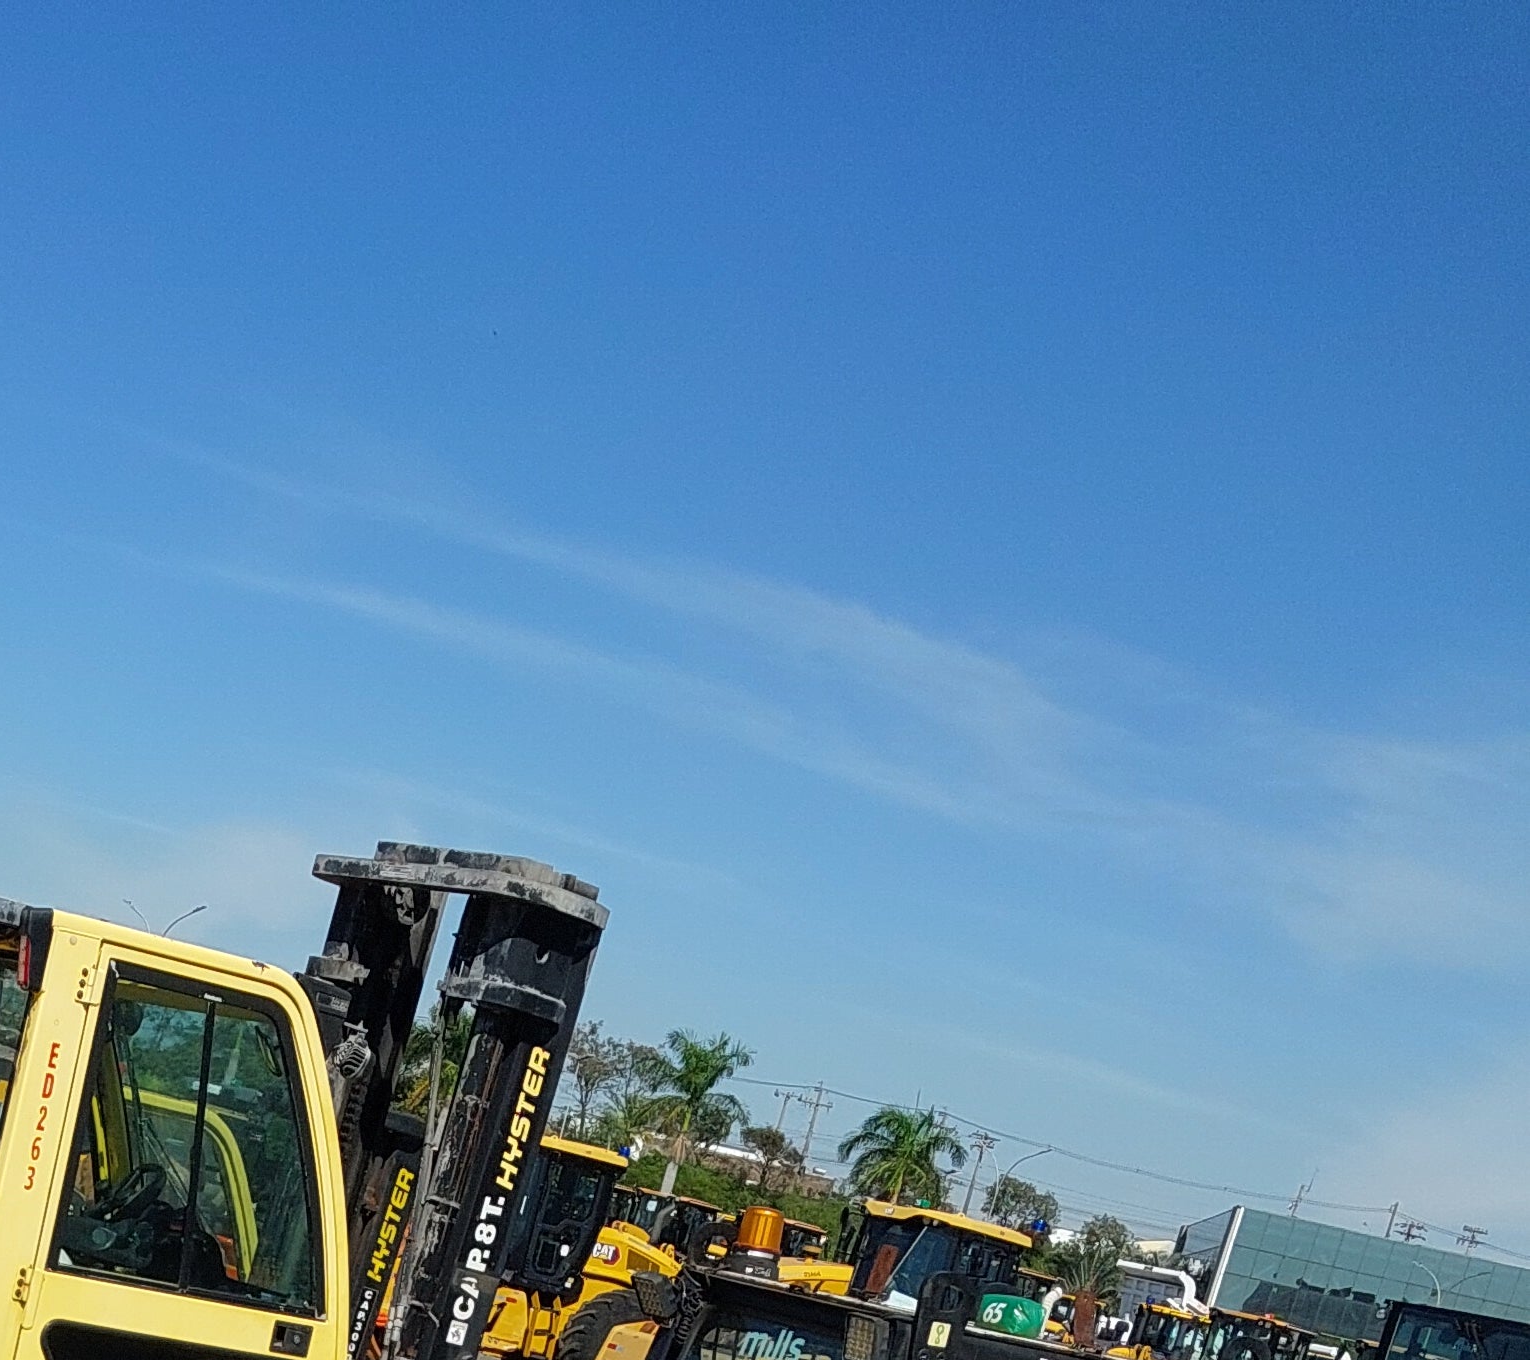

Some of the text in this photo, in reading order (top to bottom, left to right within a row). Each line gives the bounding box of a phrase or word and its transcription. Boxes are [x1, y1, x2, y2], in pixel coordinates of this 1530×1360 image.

[496, 1046, 551, 1191] HYSTER
[366, 1167, 415, 1283] HYSTER
[592, 1242, 616, 1261] CAT
[982, 1302, 1008, 1324] 65
